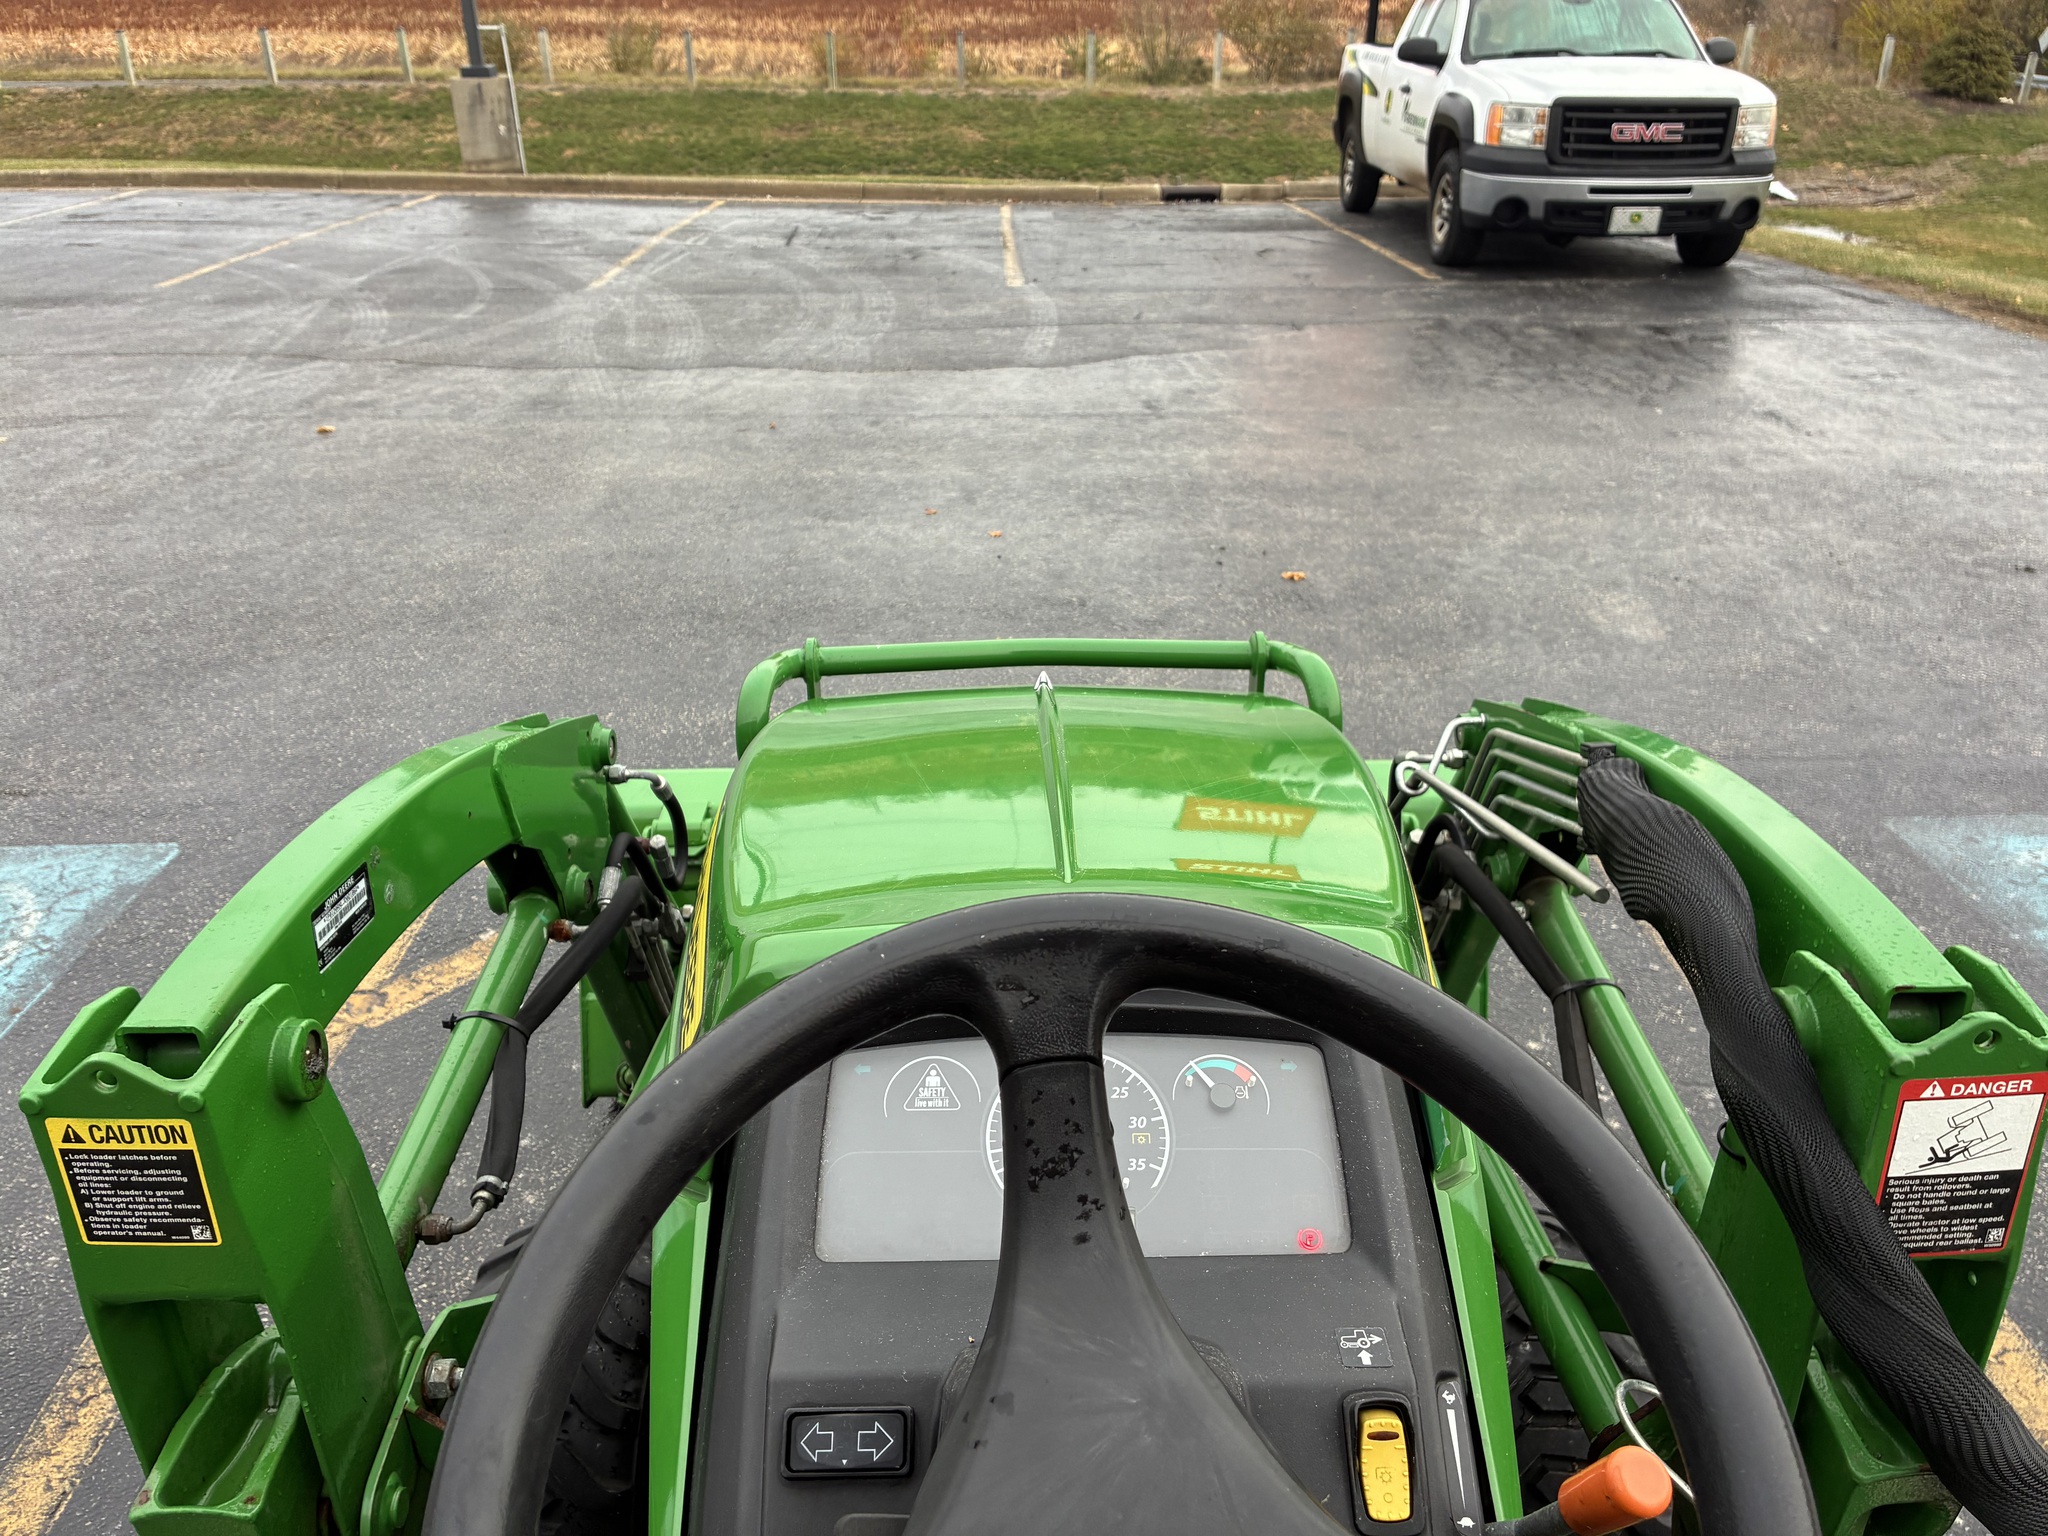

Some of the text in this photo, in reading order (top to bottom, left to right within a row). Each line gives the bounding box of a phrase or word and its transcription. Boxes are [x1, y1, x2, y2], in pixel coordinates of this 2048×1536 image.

[1610, 122, 1686, 143] GMC
[1189, 863, 1293, 877] STIHL
[324, 892, 339, 910] JOHN
[919, 1087, 947, 1097] SAFETY
[1110, 1086, 1129, 1099] 25
[1950, 1079, 2033, 1096] DANGER
[914, 1098, 949, 1107] live with it
[1128, 1116, 1147, 1128] 30
[88, 1124, 188, 1144] CAUTION
[1127, 1158, 1146, 1171] 35
[1921, 1177, 1945, 1185] injury
[1958, 1174, 1982, 1182] death
[1886, 1185, 1910, 1193] result
[1933, 1183, 1972, 1191] rollovers.
[1922, 1190, 1951, 1198] handle
[1952, 1188, 1978, 1196] round
[1989, 1187, 2010, 1195] large
[1949, 1202, 1982, 1211] seatbelt
[95, 1209, 133, 1217] hydraulic
[1922, 1219, 1950, 1227] tractor
[1978, 1215, 2005, 1223] speed.
[1909, 1226, 1938, 1234] wheels
[1944, 1232, 1974, 1240] setting.
[1954, 1237, 1983, 1245] ballast.
